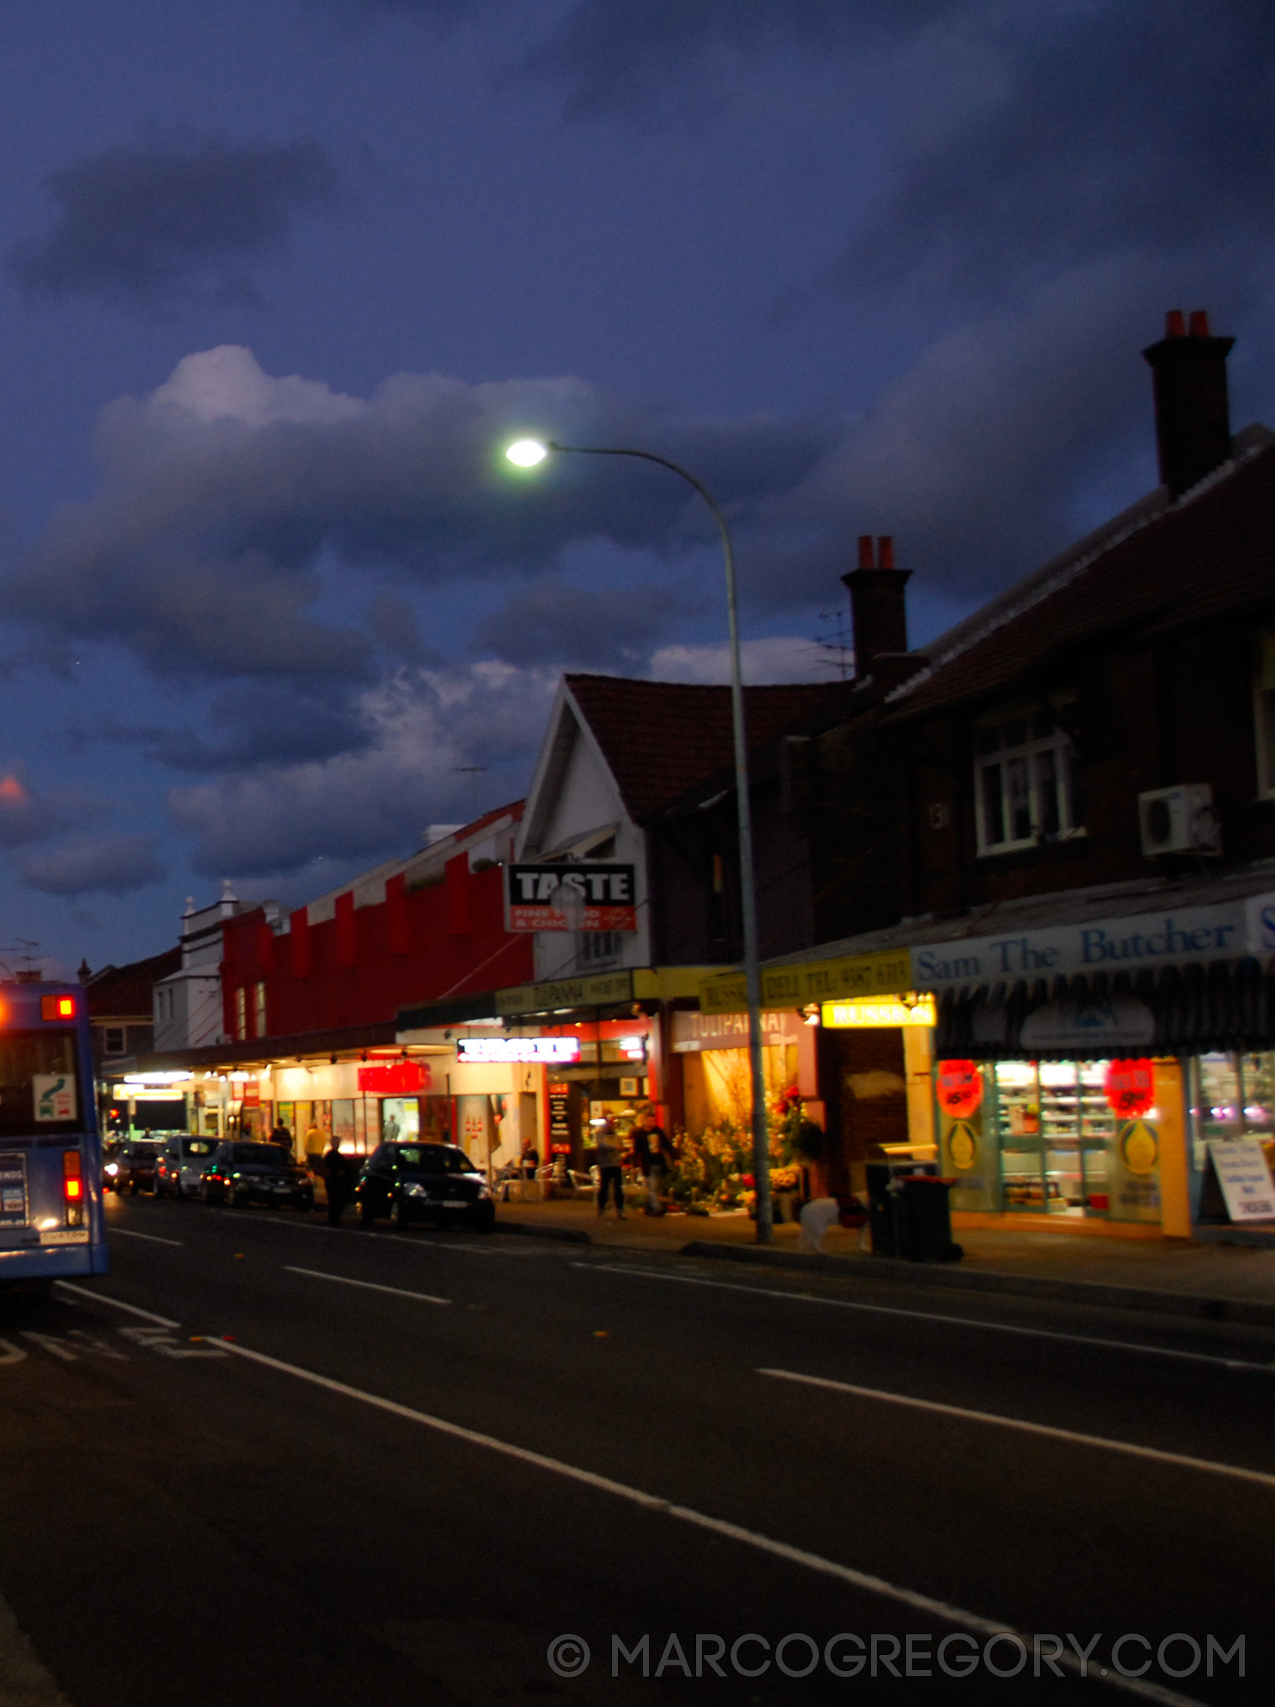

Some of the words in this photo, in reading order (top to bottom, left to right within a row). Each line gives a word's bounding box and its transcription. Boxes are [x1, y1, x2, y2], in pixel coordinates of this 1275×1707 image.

[515, 872, 630, 901] TASTE
[532, 919, 600, 928] CHICN
[915, 951, 981, 983] Sam
[991, 938, 1060, 973] The
[1080, 919, 1234, 964] Butcher
[767, 974, 800, 998] DELI
